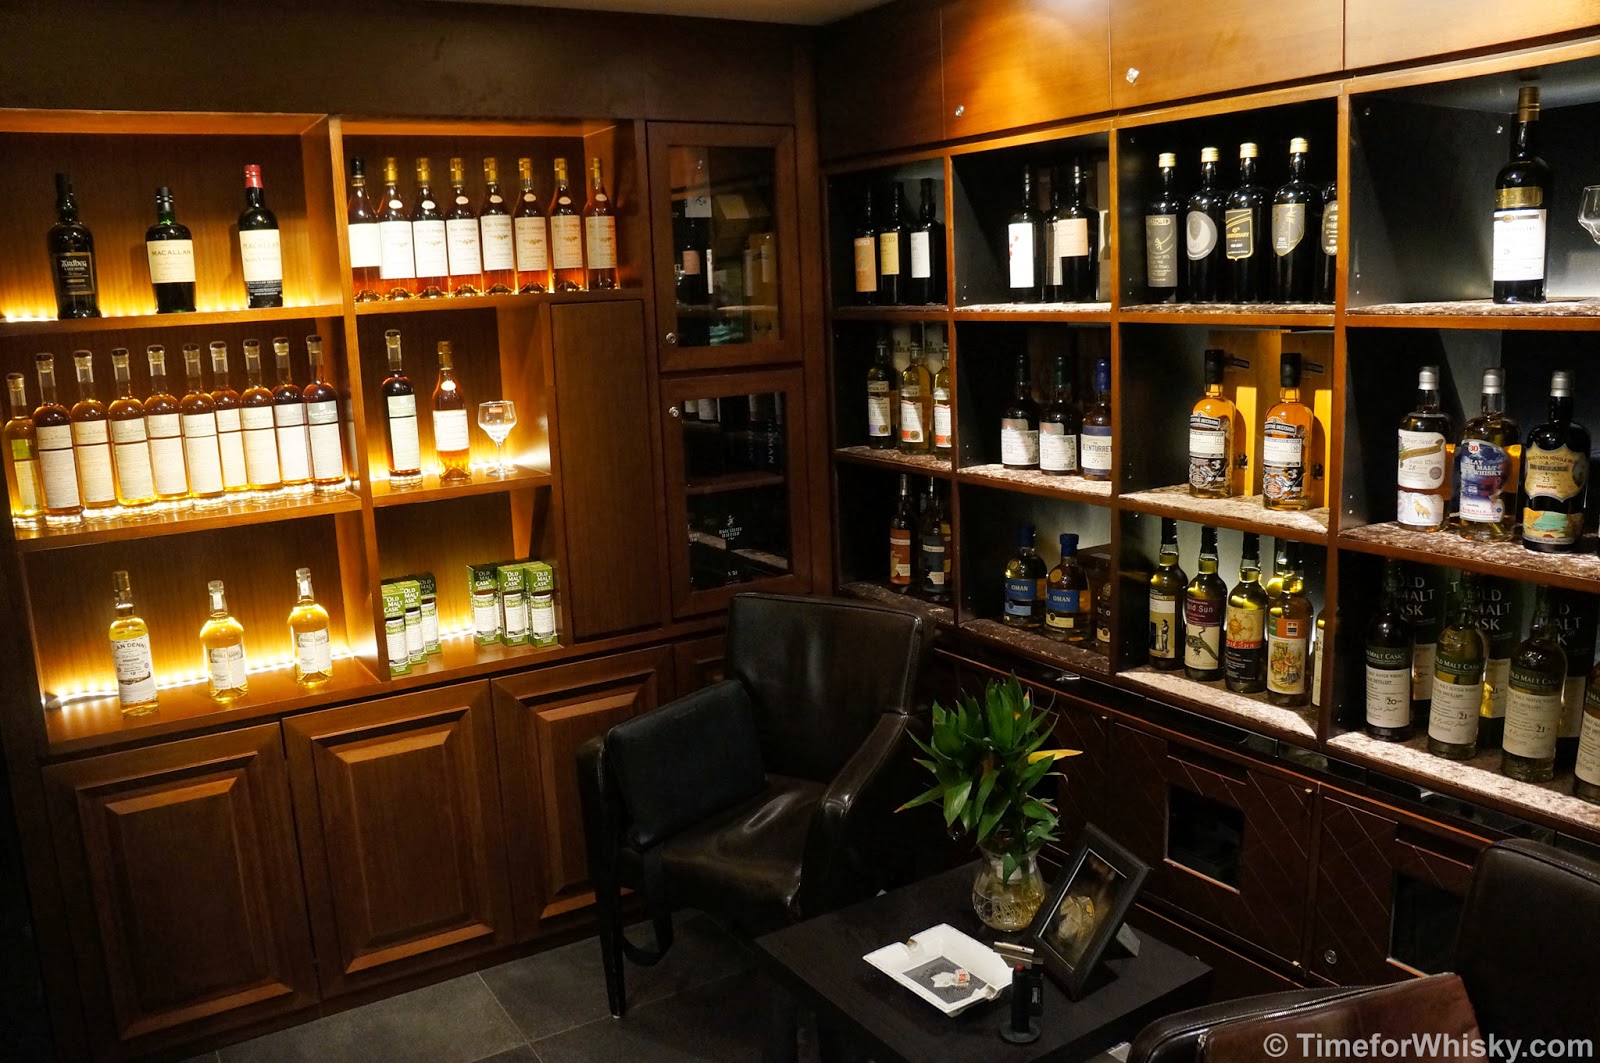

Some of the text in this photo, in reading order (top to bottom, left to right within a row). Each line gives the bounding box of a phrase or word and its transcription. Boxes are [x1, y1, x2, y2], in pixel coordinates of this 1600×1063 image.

[1198, 605, 1213, 613] Sun
[1444, 660, 1461, 669] MALT
[1520, 675, 1540, 684] MALT
